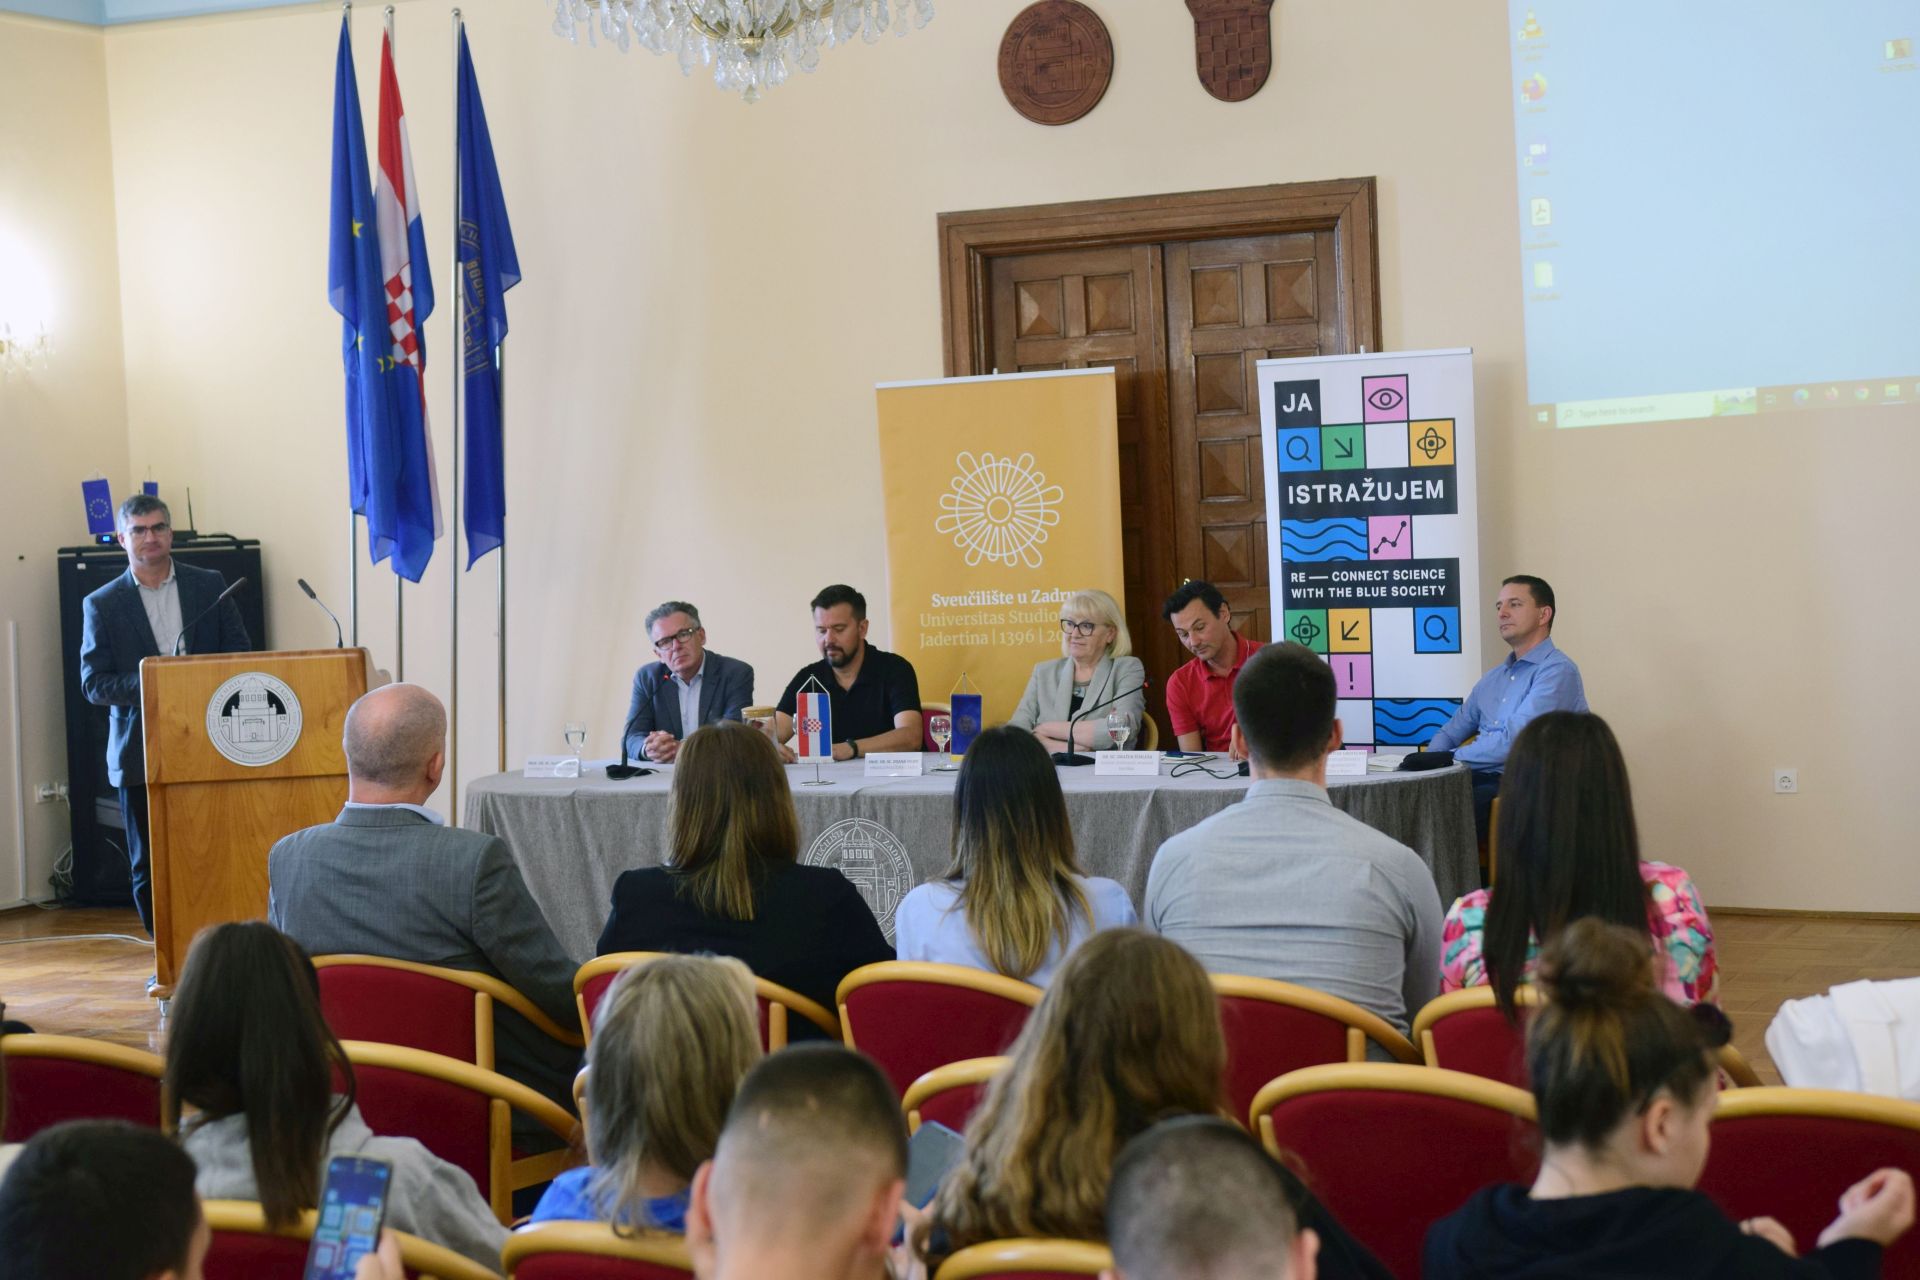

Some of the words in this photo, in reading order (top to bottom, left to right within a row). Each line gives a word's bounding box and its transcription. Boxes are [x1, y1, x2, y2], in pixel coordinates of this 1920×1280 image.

[1282, 392, 1313, 413] JA
[1288, 477, 1444, 505] ISTRAŽUJEM
[1291, 572, 1306, 583] RE
[1332, 570, 1389, 582] CONNECT
[1392, 569, 1446, 581] SCIENCE
[931, 589, 1014, 608] Sveučilište
[1017, 592, 1028, 604] u
[1291, 587, 1324, 599] WITH
[1328, 587, 1352, 598] THE
[1356, 586, 1387, 597] BLUE
[1391, 585, 1446, 597] SOCIETY
[920, 610, 1005, 627] Universitas
[1008, 608, 1058, 625] Studio
[920, 631, 988, 649] Jadertina
[999, 628, 1034, 647] 1396
[811, 828, 845, 866] VEUČILIŠTE
[882, 840, 905, 869] ZADRU
